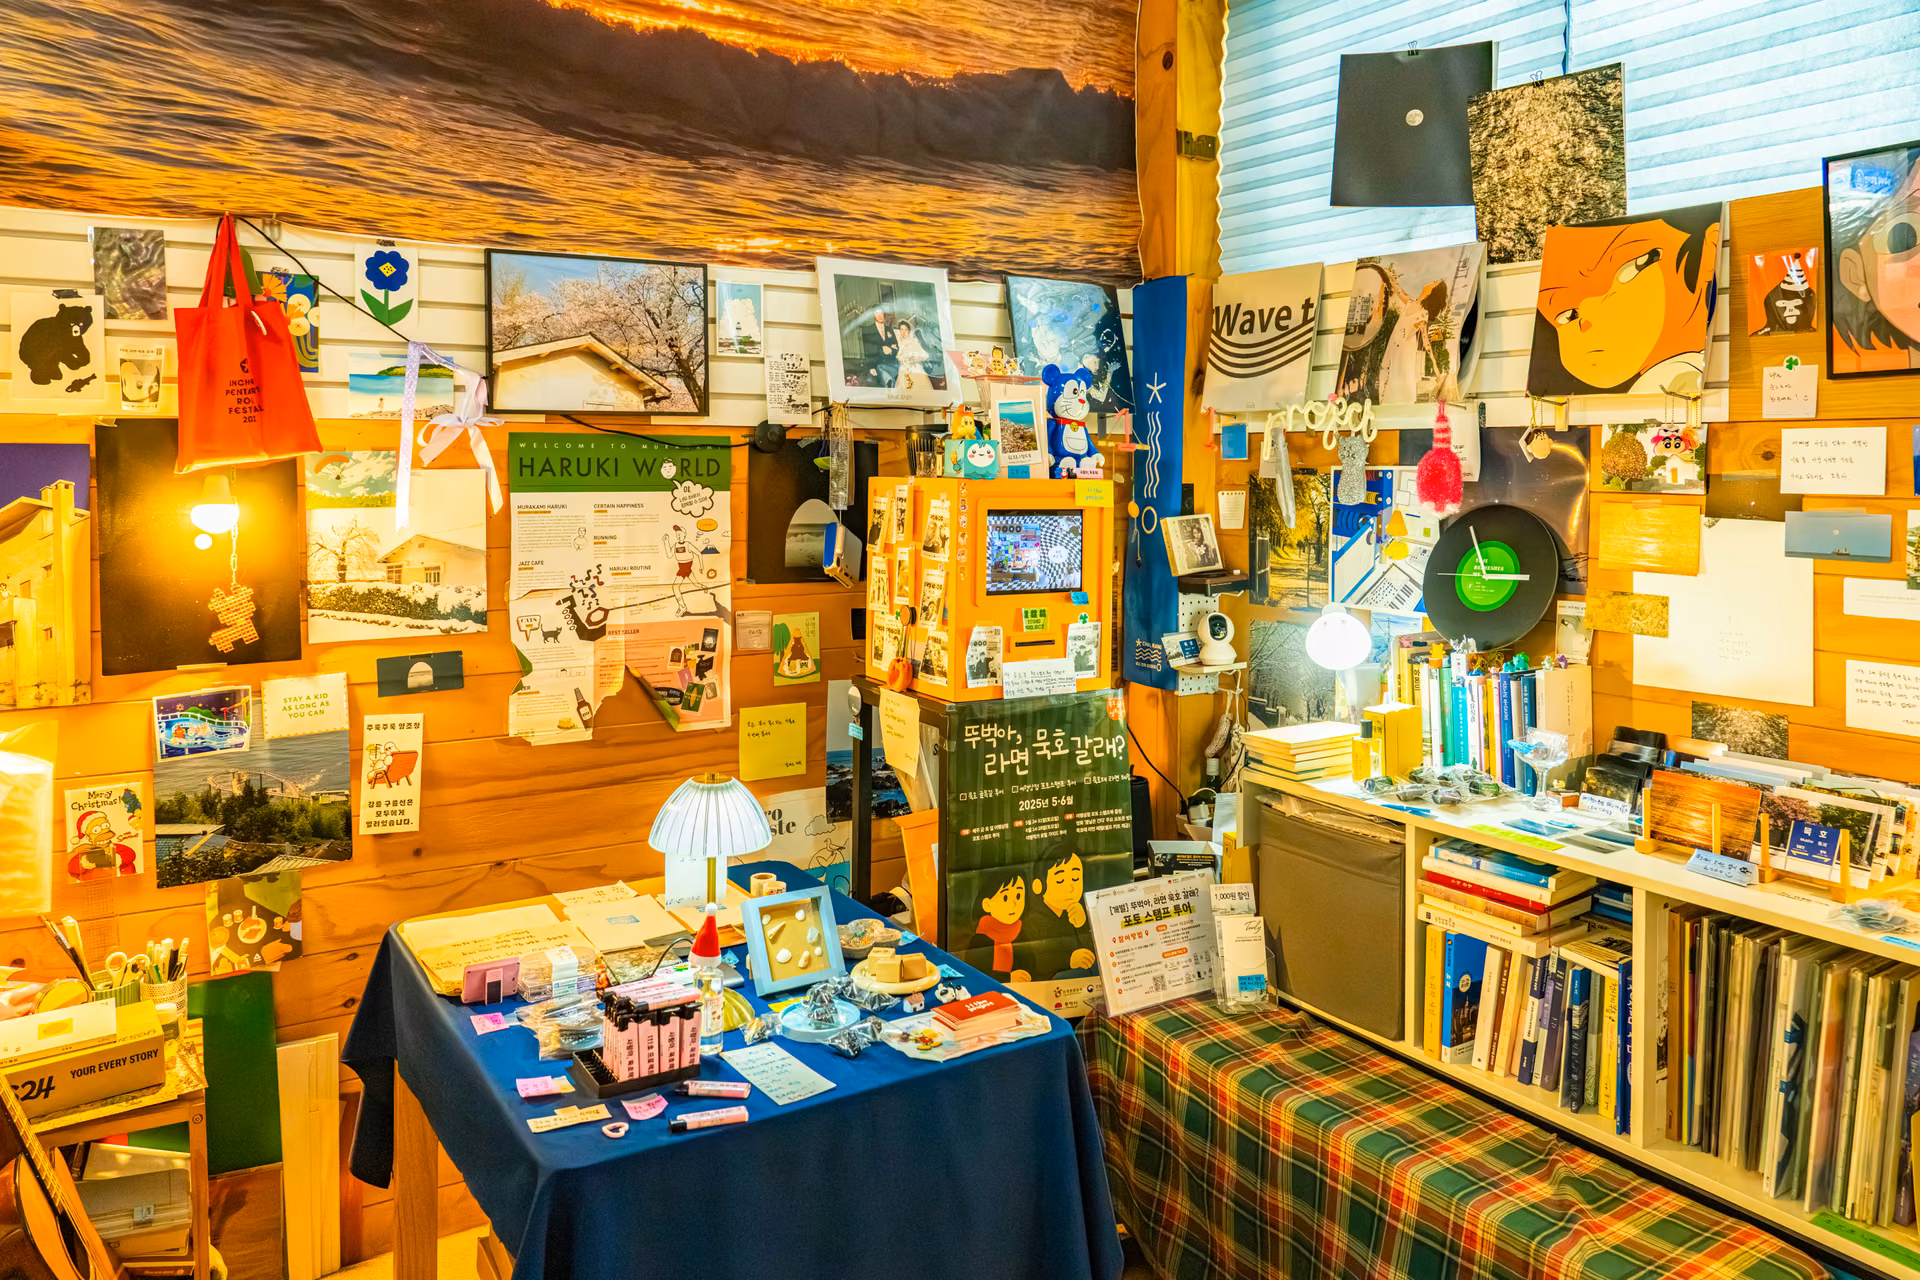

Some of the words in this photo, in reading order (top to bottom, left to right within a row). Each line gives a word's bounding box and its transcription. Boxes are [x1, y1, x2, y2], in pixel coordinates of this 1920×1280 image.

[1215, 302, 1292, 336] Wave
[519, 457, 619, 478] HARUKI
[295, 702, 317, 710] LONG
[964, 723, 1022, 749] 뚜벅아,
[1032, 729, 1069, 760] 묵호
[985, 748, 1029, 775] 라면
[1071, 735, 1126, 765] 갈래?
[71, 796, 121, 811] Christmas!
[88, 791, 112, 799] Merry
[1019, 798, 1049, 811] 2025년
[376, 809, 405, 817] 모두에게
[1131, 899, 1153, 911] 뚜벅아,
[1153, 895, 1167, 906] 라면
[1168, 891, 1181, 903] 묵호
[1183, 888, 1200, 899] 갈래?
[1215, 891, 1236, 900] 1,000원
[1238, 890, 1250, 900] 할인
[1123, 914, 1141, 927] 포토
[1145, 908, 1172, 923] 스탬프
[1173, 902, 1192, 916] 투어
[70, 1065, 97, 1079] YOUR
[98, 1057, 127, 1072] EVERY
[129, 1049, 159, 1064] STORY
